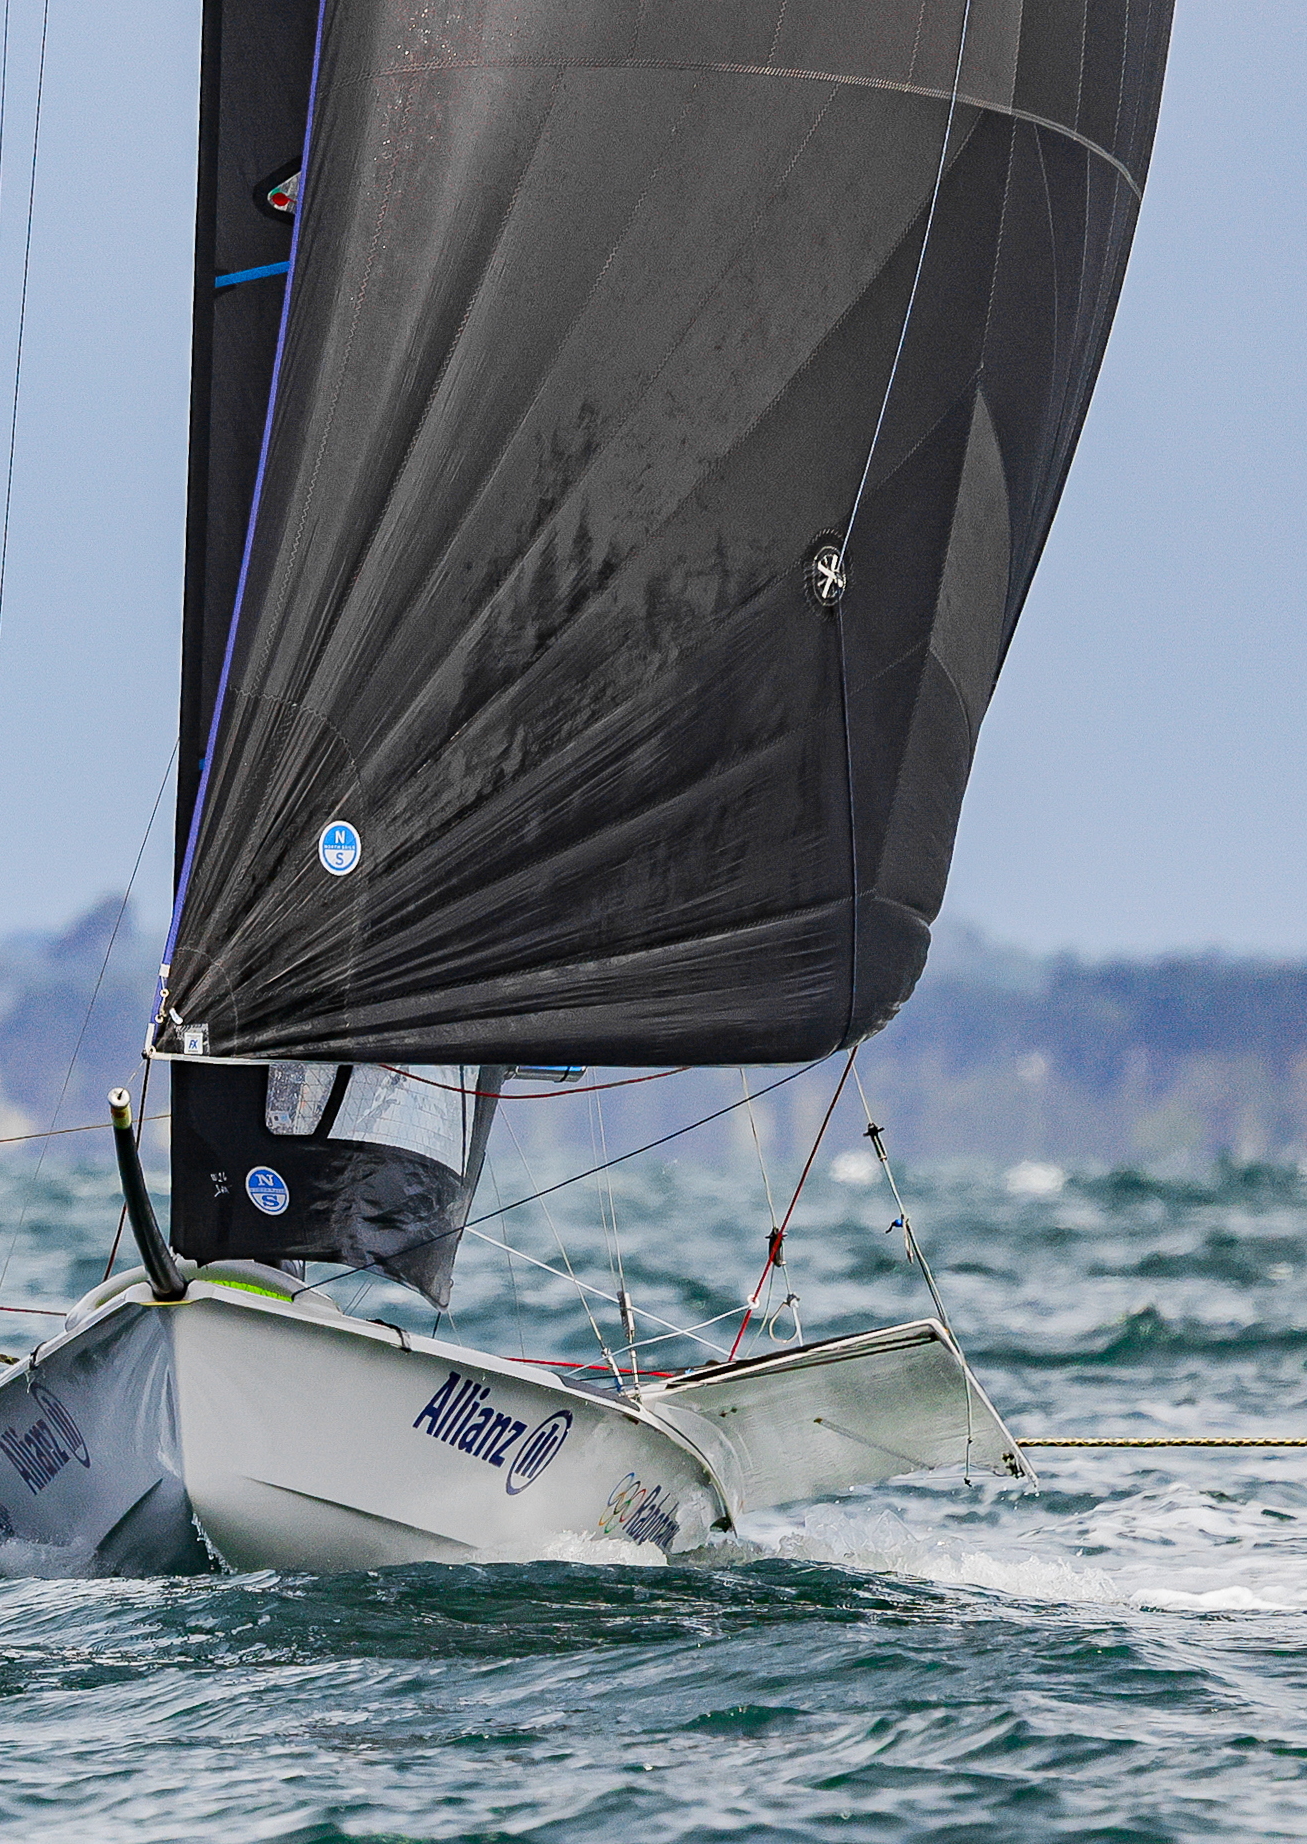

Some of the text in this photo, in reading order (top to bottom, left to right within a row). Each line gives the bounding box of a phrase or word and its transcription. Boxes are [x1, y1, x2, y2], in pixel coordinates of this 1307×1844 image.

[335, 830, 346, 844] N
[335, 852, 344, 866] S
[255, 1173, 274, 1187] N
[261, 1194, 280, 1207] S
[412, 1371, 528, 1468] Allianz
